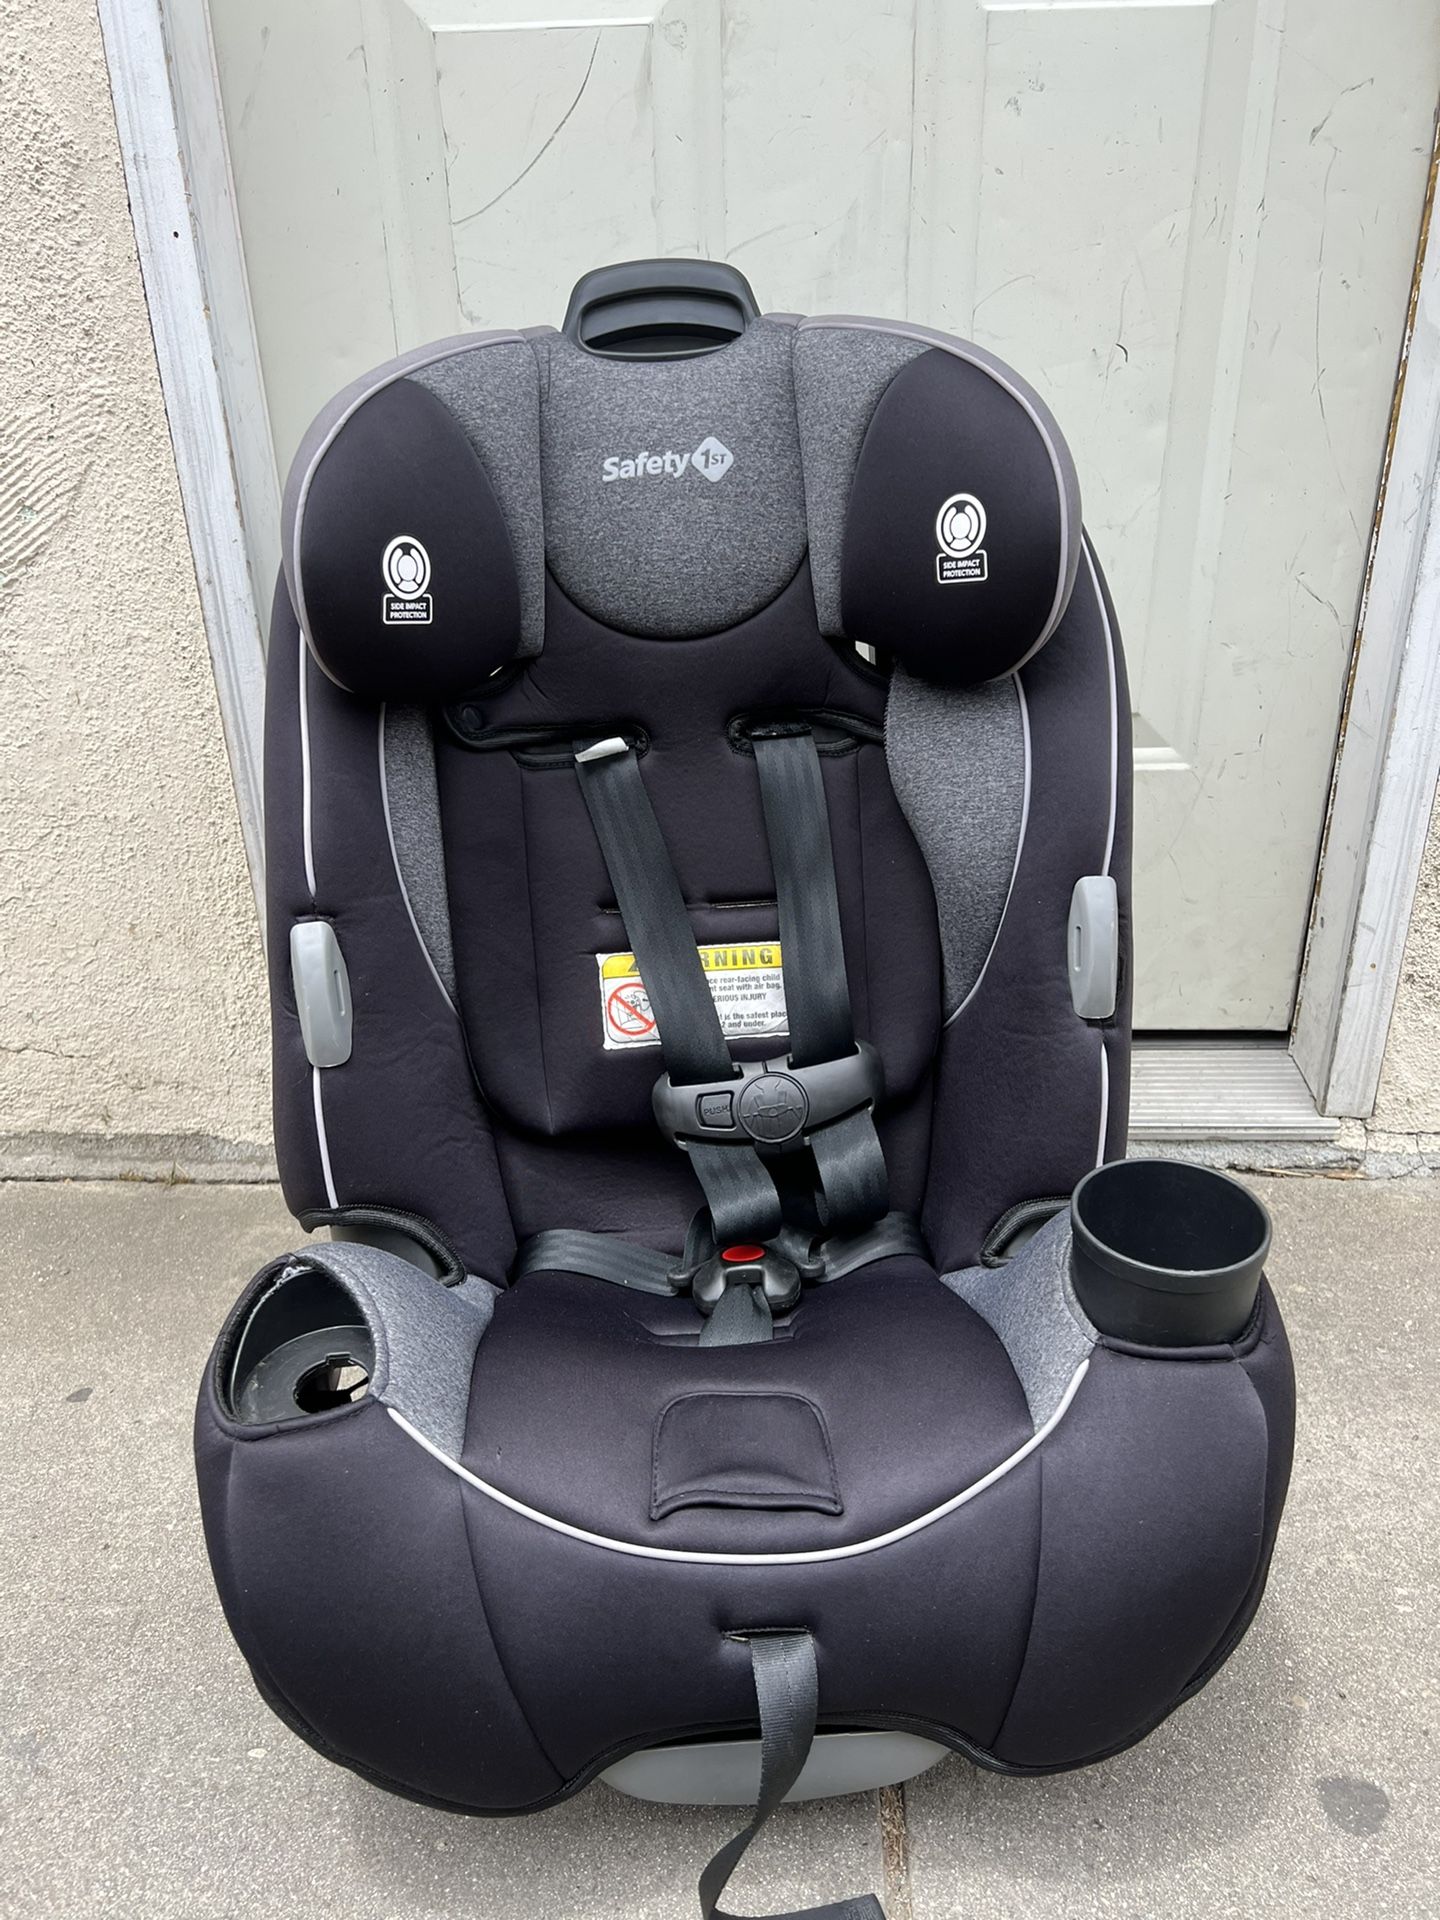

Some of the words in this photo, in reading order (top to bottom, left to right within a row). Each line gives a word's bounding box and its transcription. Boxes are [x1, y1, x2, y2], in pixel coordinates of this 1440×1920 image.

[602, 450, 690, 482] Safety
[943, 561, 956, 569] SIDE
[957, 559, 980, 568] IMPACT
[943, 568, 981, 578] PROTECTION
[390, 602, 405, 610] SIDE
[405, 602, 427, 610] IMPACT
[390, 611, 427, 619] PROTECTION
[700, 948, 773, 967] RNING
[720, 975, 761, 984] rear-facing
[762, 974, 780, 982] child
[736, 983, 753, 991] with
[754, 982, 764, 990] air
[714, 994, 739, 1002] ERIOUS
[740, 993, 767, 1001] INJURY
[733, 1012, 744, 1020] the
[746, 1011, 769, 1019] safest
[771, 1010, 786, 1018] plac
[727, 1020, 742, 1028] and
